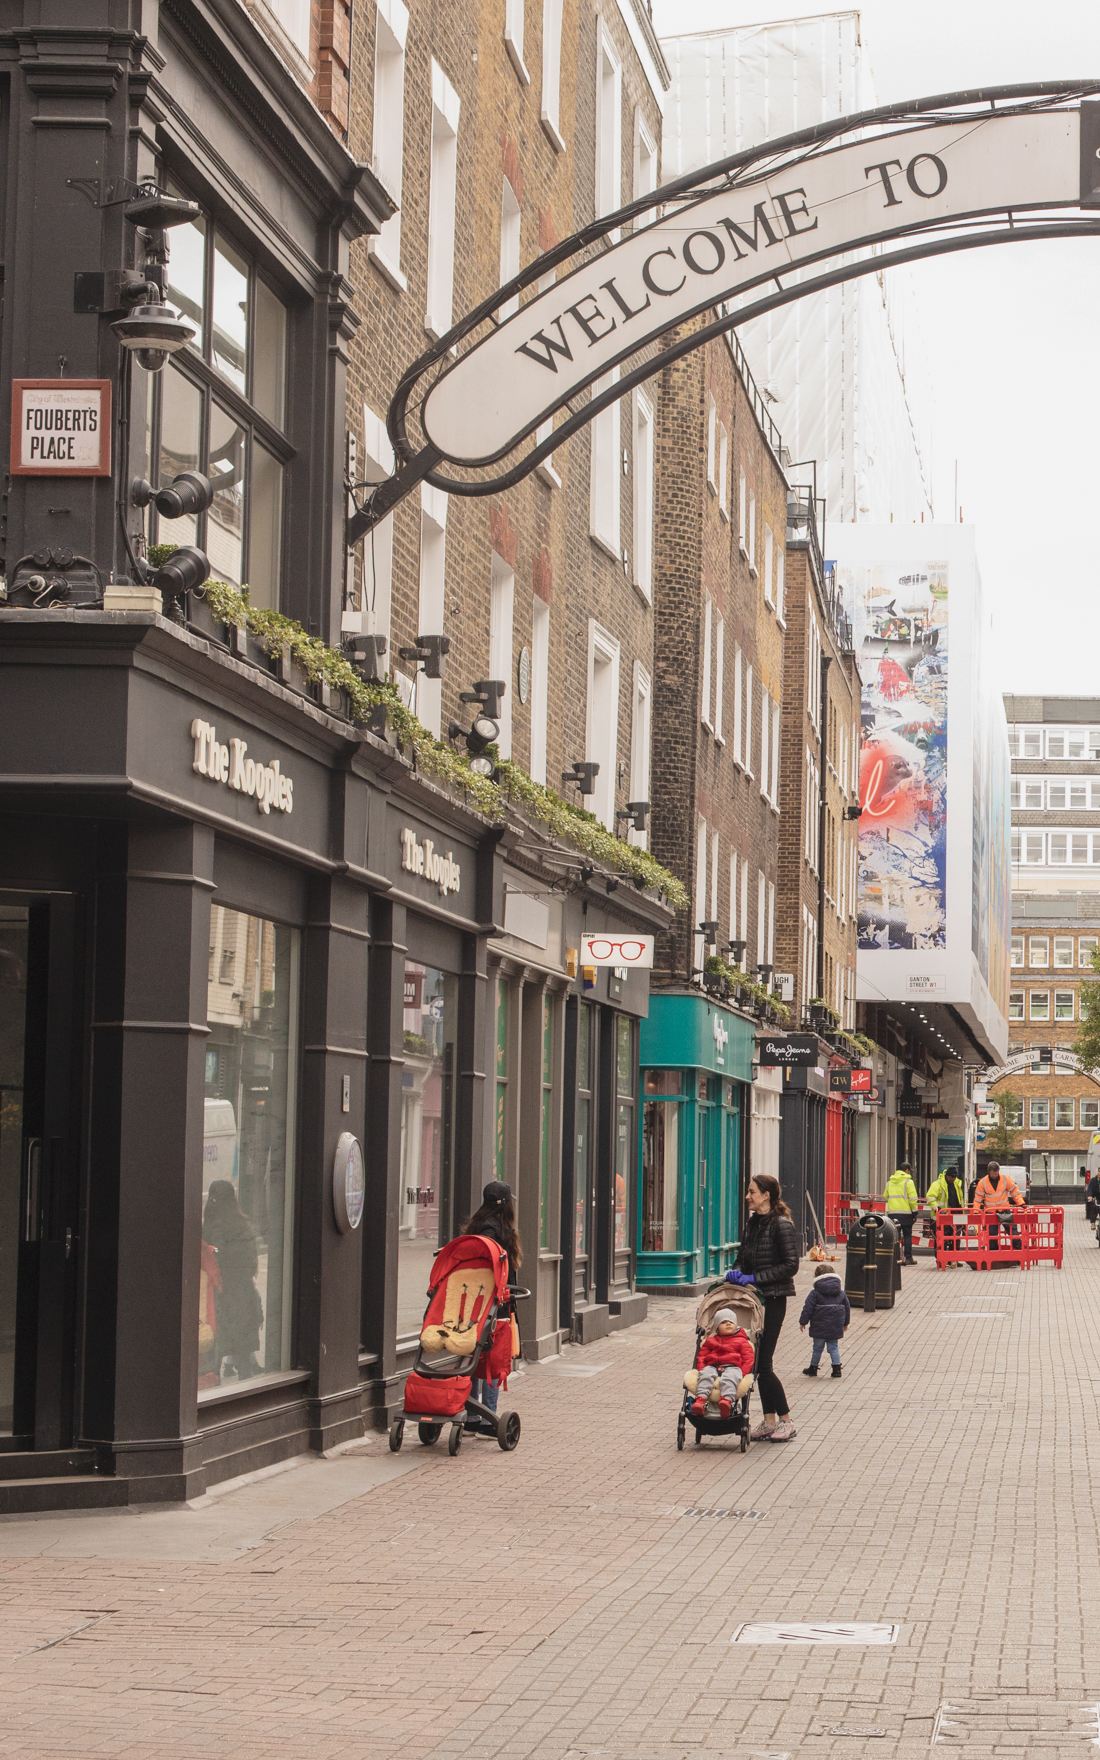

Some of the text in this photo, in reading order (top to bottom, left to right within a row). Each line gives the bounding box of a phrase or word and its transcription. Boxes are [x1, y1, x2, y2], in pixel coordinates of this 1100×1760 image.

[514, 187, 818, 373] WELCOME
[864, 153, 948, 208] TO
[26, 407, 97, 432] FOUBERT'S
[30, 436, 75, 460] PLACE
[191, 718, 293, 815] The Kooples
[401, 827, 460, 896] The Kooples
[766, 1042, 811, 1057] Pepe Jeans
